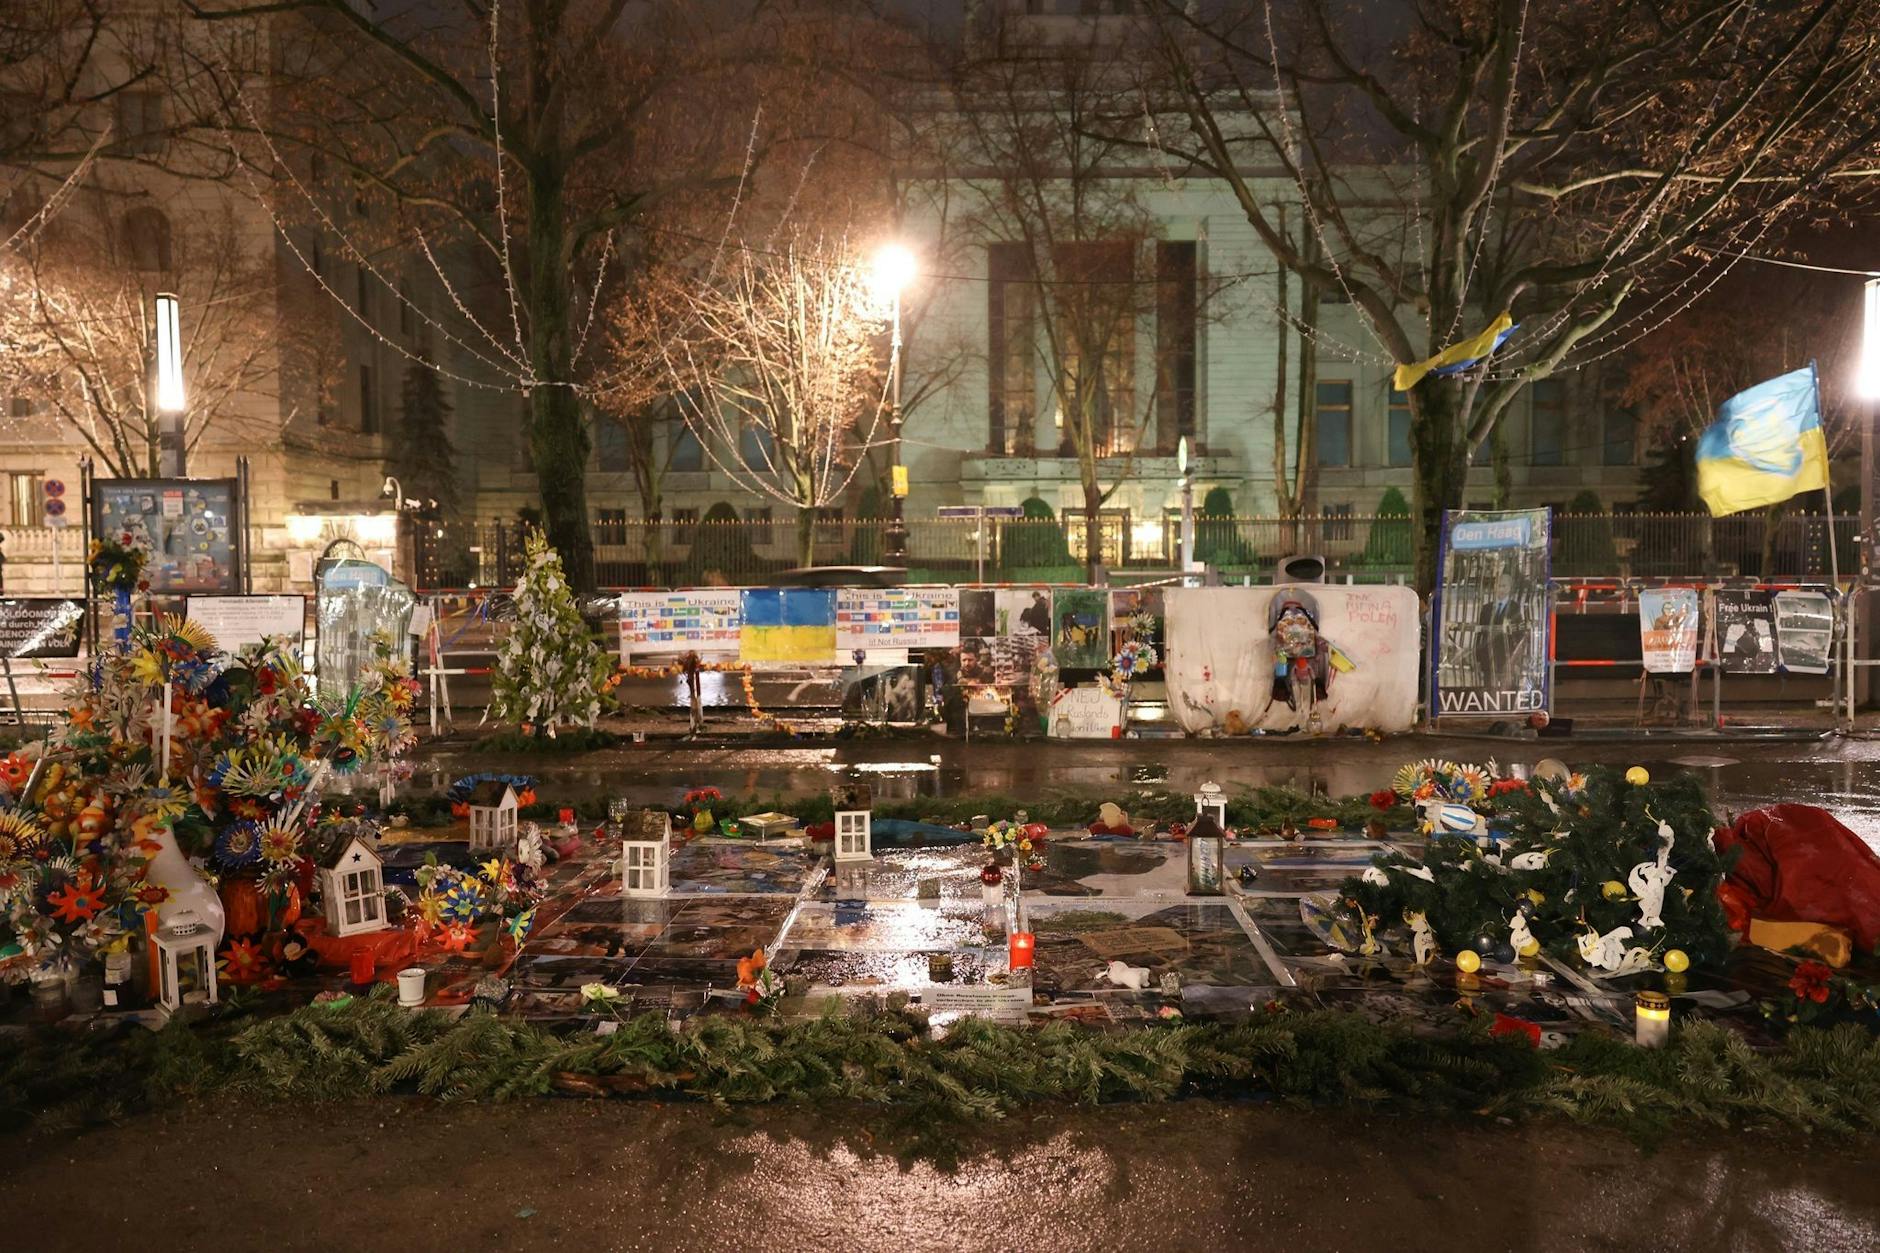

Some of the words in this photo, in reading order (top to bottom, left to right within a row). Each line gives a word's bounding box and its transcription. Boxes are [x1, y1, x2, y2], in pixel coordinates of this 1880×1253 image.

[1457, 527, 1482, 541] Den
[628, 600, 651, 608] This
[655, 600, 665, 608] is
[688, 598, 736, 607] Ukraine
[1719, 603, 1739, 613] Free
[1741, 603, 1767, 613] Ukrain
[877, 638, 891, 647] Not
[1071, 689, 1101, 704] NEJ
[1439, 690, 1544, 712] WANTED
